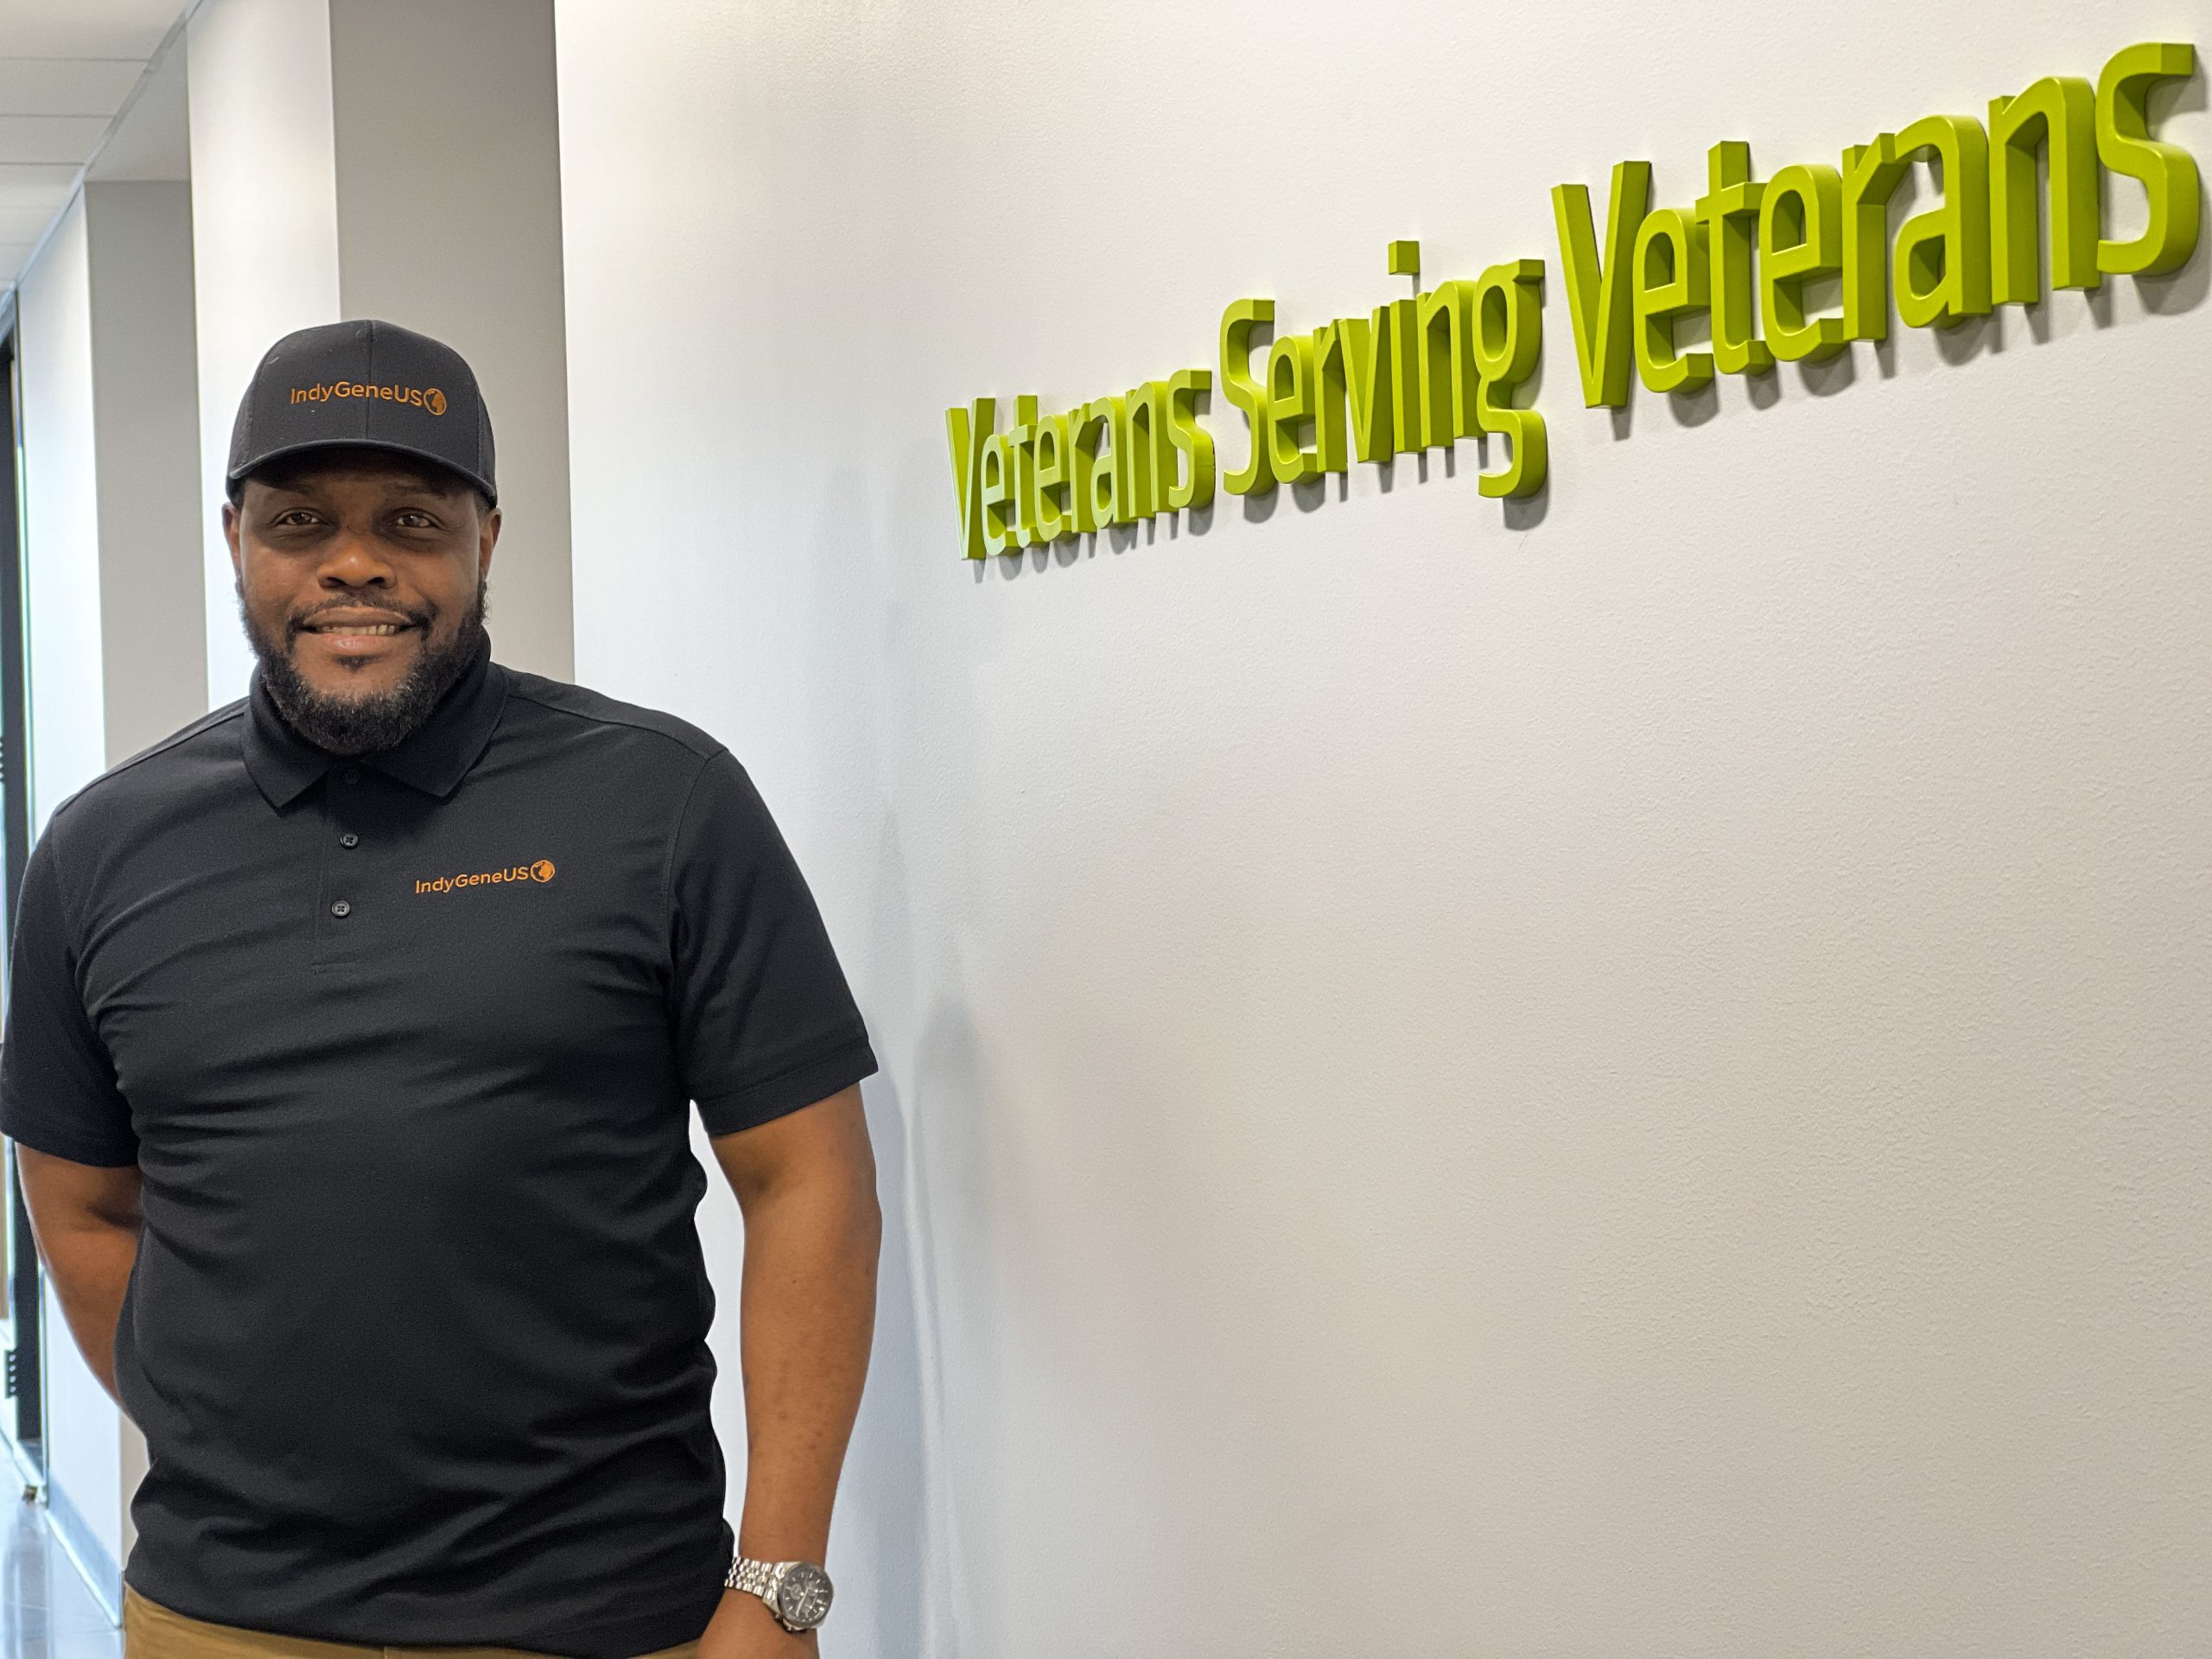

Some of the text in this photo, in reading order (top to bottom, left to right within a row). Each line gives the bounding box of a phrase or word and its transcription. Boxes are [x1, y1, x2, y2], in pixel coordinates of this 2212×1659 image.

[946, 41, 2202, 559] Veterans Serving Veterans
[289, 381, 423, 407] IndyGeneUS
[415, 867, 529, 893] IndyGeneUS
